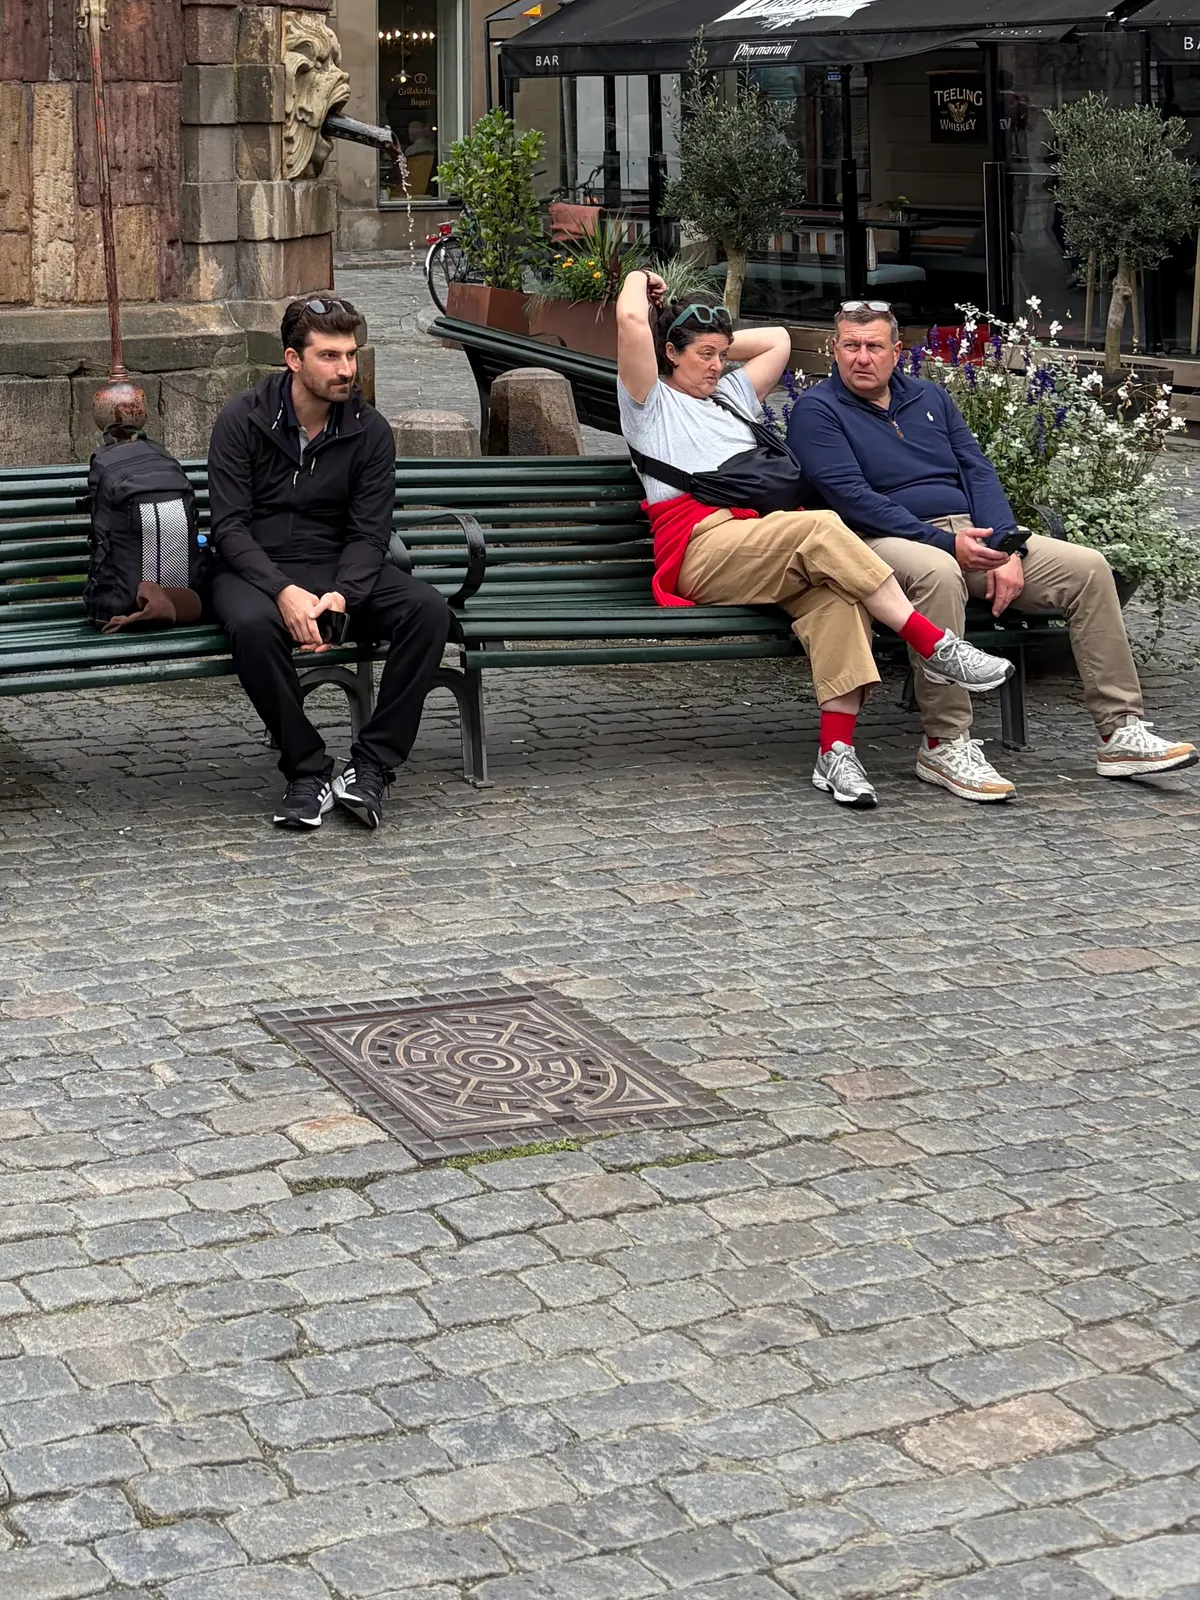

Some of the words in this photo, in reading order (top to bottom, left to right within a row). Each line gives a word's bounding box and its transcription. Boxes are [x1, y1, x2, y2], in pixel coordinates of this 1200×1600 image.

[732, 42, 792, 61] Pharmarium
[535, 55, 560, 67] BAR
[934, 87, 983, 106] TEELING
[940, 119, 976, 132] WHISKEY
